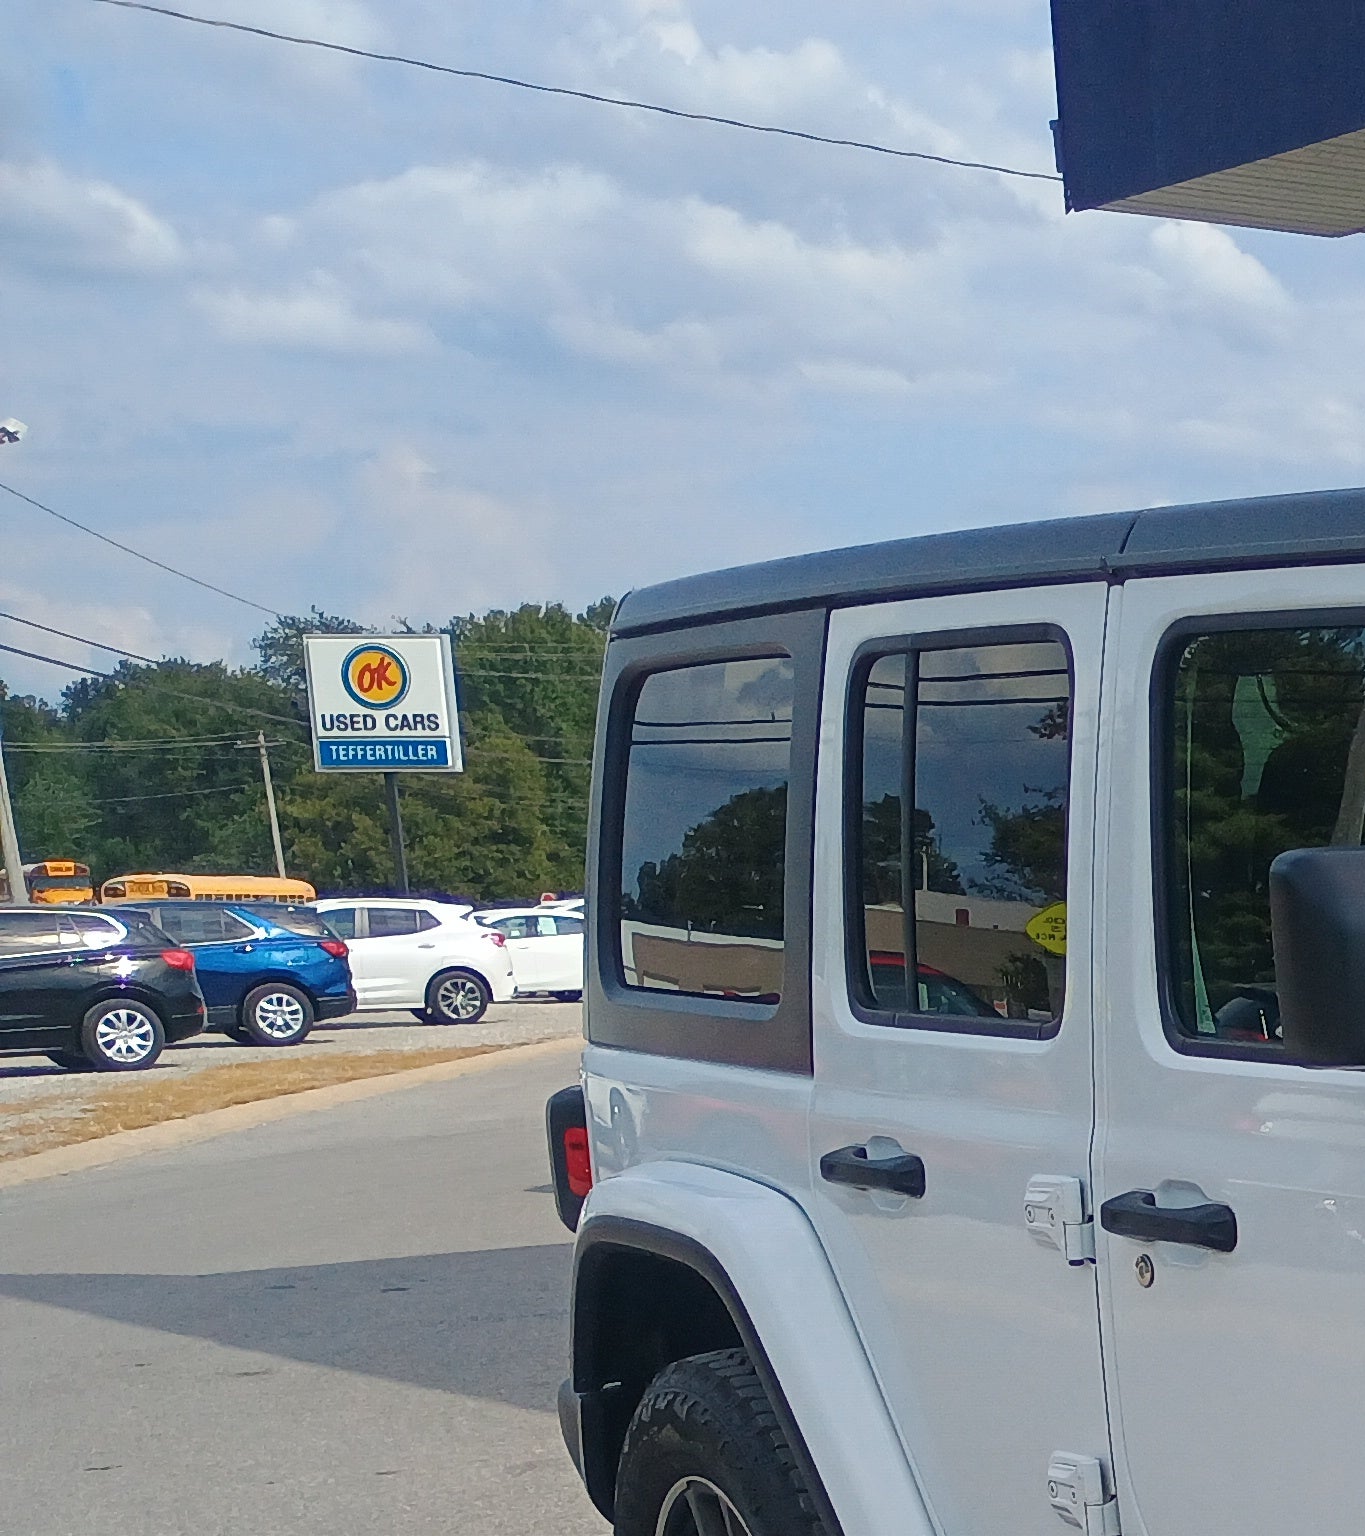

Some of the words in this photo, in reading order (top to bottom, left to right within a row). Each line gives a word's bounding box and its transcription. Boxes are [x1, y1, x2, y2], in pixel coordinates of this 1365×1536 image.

[357, 656, 398, 694] OK
[320, 713, 377, 732] USED
[384, 713, 440, 732] CARS
[329, 744, 438, 761] TEFFERTILLER
